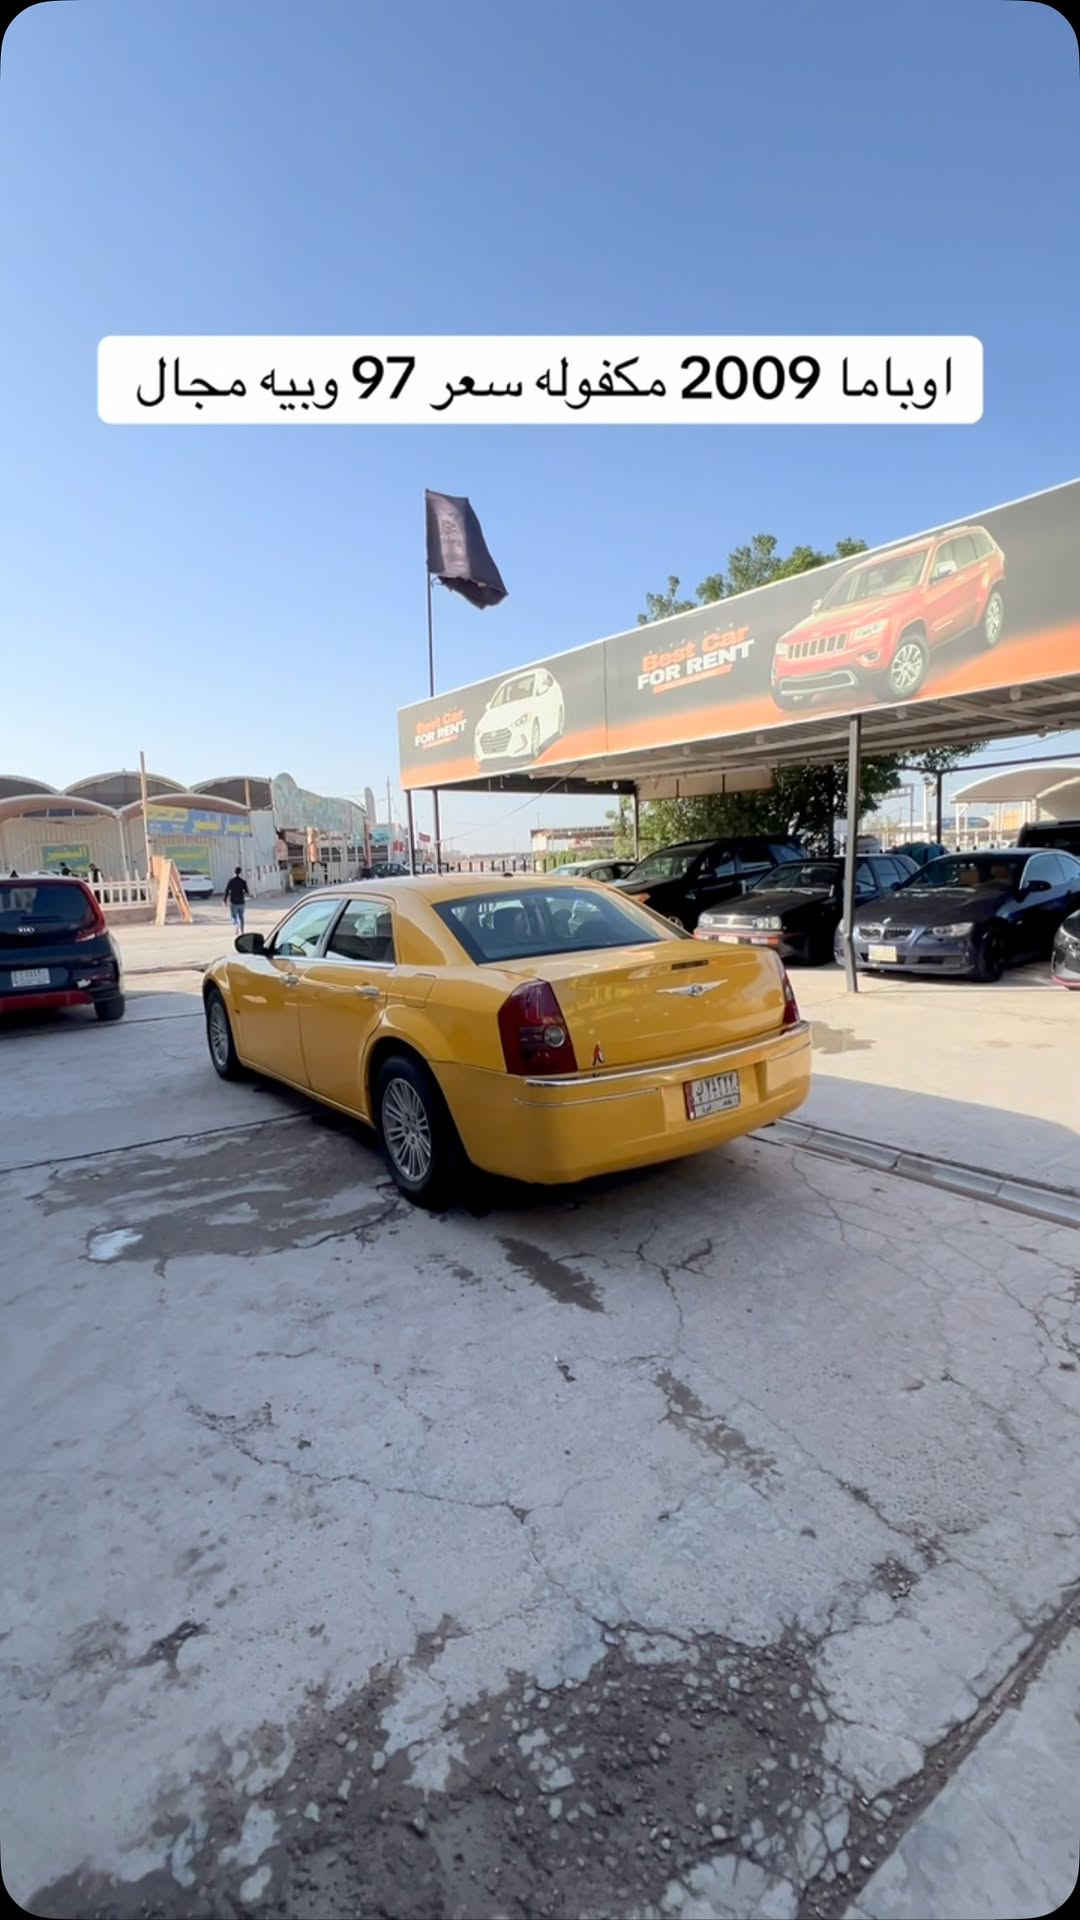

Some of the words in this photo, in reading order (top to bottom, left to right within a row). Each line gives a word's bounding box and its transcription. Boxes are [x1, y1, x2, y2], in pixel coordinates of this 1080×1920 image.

[637, 663, 681, 690] FOR
[686, 639, 756, 675] RENT
[643, 641, 696, 672] Best
[702, 626, 749, 653] Car
[415, 731, 435, 747] FOR
[436, 719, 467, 739] RENT
